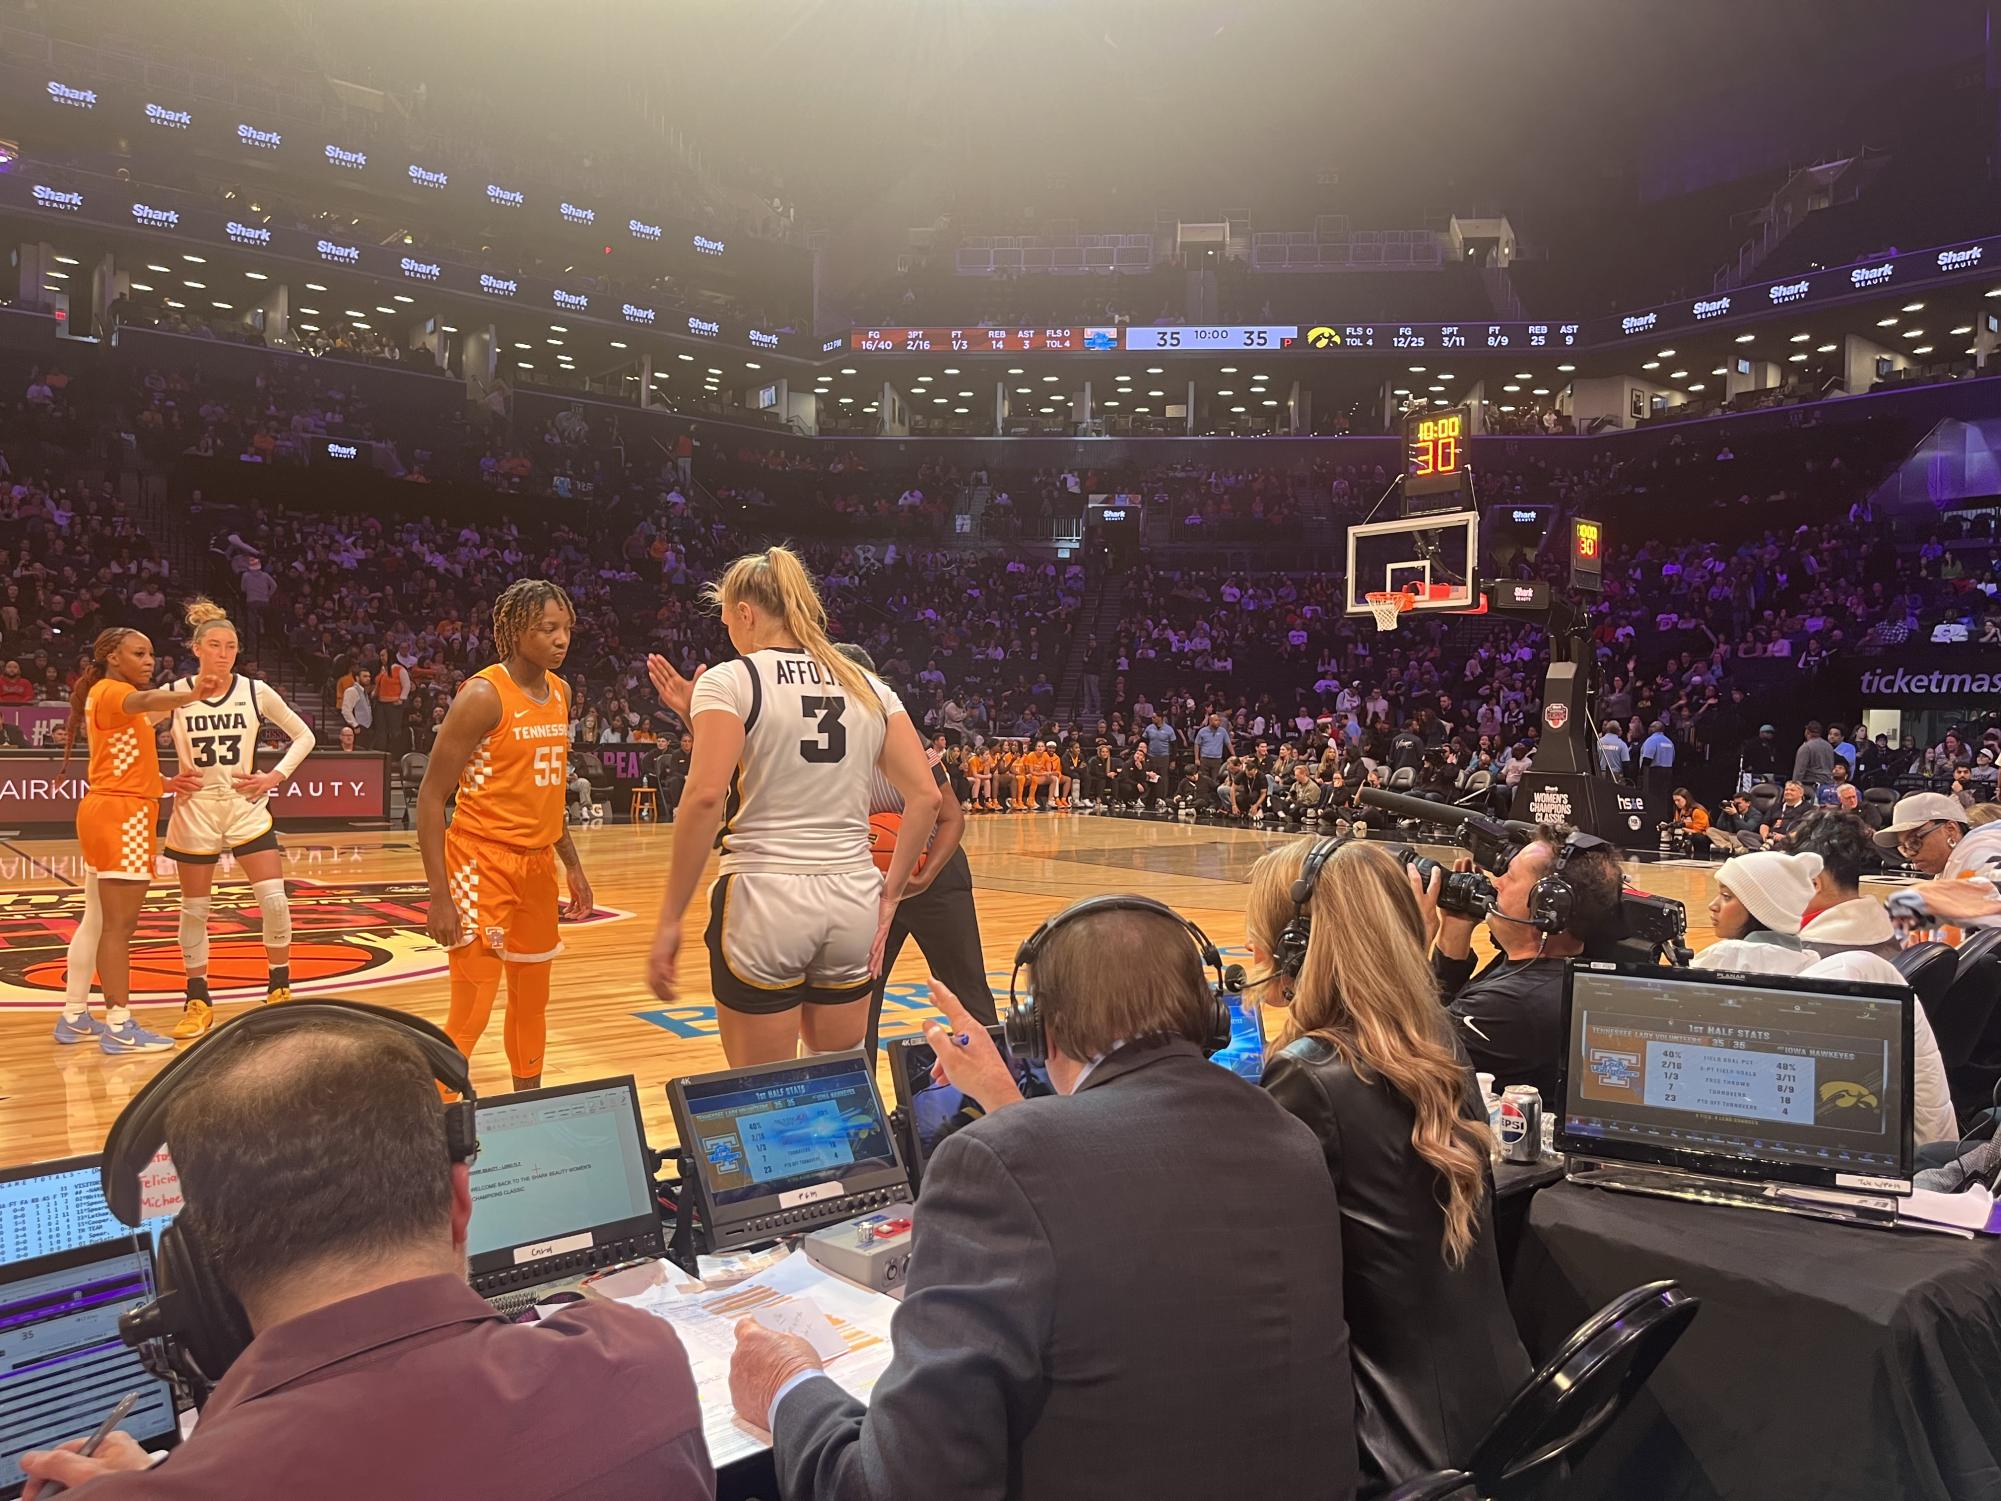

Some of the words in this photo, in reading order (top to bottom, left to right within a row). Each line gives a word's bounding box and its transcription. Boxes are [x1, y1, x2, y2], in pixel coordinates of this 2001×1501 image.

[46, 81, 97, 103] Shark
[53, 96, 92, 109] BEAUTY
[145, 103, 192, 124] Shark
[150, 117, 187, 129] BEAUTY
[237, 124, 282, 145] Shark
[242, 138, 277, 149] BEAUTY
[324, 145, 367, 165] Shark
[329, 158, 363, 169] BEAUTY
[408, 165, 448, 185] Shark
[412, 178, 444, 189] BEAUTY
[32, 185, 83, 206] Shark
[486, 184, 524, 203] Shark
[38, 200, 78, 211] BEAUTY
[491, 197, 520, 208] BEAUTY
[132, 204, 179, 223] Shark
[560, 203, 595, 221] Shark
[137, 218, 175, 228] BEAUTY
[564, 215, 592, 225] BEAUTY
[225, 221, 272, 242] Shark
[629, 219, 662, 237] Shark
[230, 235, 267, 246] BEAUTY
[632, 231, 659, 241] BEAUTY
[693, 235, 725, 252] Shark
[316, 240, 360, 259] Shark
[697, 246, 722, 256] BEAUTY
[321, 253, 355, 264] BEAUTY
[1937, 246, 1983, 266] Shark
[400, 258, 441, 276] Shark
[1942, 259, 1978, 271] BEAUTY
[404, 270, 437, 281] BEAUTY
[1850, 263, 1894, 282] Shark
[479, 274, 517, 292] Shark
[1855, 276, 1889, 288] BEAUTY
[483, 286, 514, 296] BEAUTY
[1769, 280, 1810, 299] Shark
[553, 289, 588, 306] Shark
[1773, 293, 1805, 304] BEAUTY
[556, 302, 585, 310] BEAUTY
[1692, 297, 1731, 314] Shark
[622, 304, 655, 320] Shark
[1696, 309, 1727, 320] BEAUTY
[625, 315, 652, 324] BEAUTY
[688, 317, 719, 333] Shark
[1622, 312, 1657, 329] Shark
[691, 328, 716, 337] BEAUTY
[1560, 325, 1578, 333] AST
[1625, 324, 1653, 334] BEAUTY
[748, 330, 779, 345] Shark
[1157, 331, 1180, 347] 35
[1194, 330, 1228, 339] 10:00
[1243, 330, 1268, 346] 35
[1393, 337, 1424, 348] 12/25
[1442, 336, 1465, 347] 3/11
[1488, 335, 1508, 347] 8/9
[1530, 336, 1545, 346] 25
[1565, 336, 1574, 345] 9
[752, 340, 776, 349] BEAUTY
[861, 341, 893, 350] 16/40
[906, 340, 930, 350] 2/16
[952, 340, 968, 350] 1/3
[992, 340, 1004, 350] 14
[1023, 340, 1030, 350] 3
[1418, 416, 1459, 441] 10:00
[328, 443, 357, 456] Shark
[1416, 437, 1455, 475] 30
[1512, 510, 1537, 519] Shark
[1580, 537, 1594, 556] 30
[1514, 587, 1534, 597] Shark
[185, 713, 247, 732] IOWA
[800, 695, 846, 763] 3
[191, 735, 242, 767] 33
[534, 746, 564, 786] 55
[1534, 792, 1568, 804] WOMEN'S
[1530, 802, 1571, 815] CHAMPIONS
[1535, 813, 1565, 823] CLASSIC
[1708, 1026, 1734, 1036] HALF
[1738, 1029, 1770, 1040] STATS
[1712, 1039, 1724, 1048] 35
[1784, 1047, 1806, 1055] IOWA
[1809, 1049, 1855, 1060] HAWKEYES
[1664, 1072, 1679, 1080] 1/3
[1776, 1073, 1796, 1083] 3/11
[768, 1088, 785, 1098] HALF
[1777, 1084, 1794, 1094] 8/9
[1665, 1094, 1676, 1102] 23
[1782, 1107, 1788, 1115] 4
[764, 1165, 773, 1174] 23
[498, 1179, 512, 1187] BACK
[549, 1168, 568, 1177] BEAUTY
[504, 1187, 524, 1195] CLASSIC
[22, 1331, 34, 1341] 35
